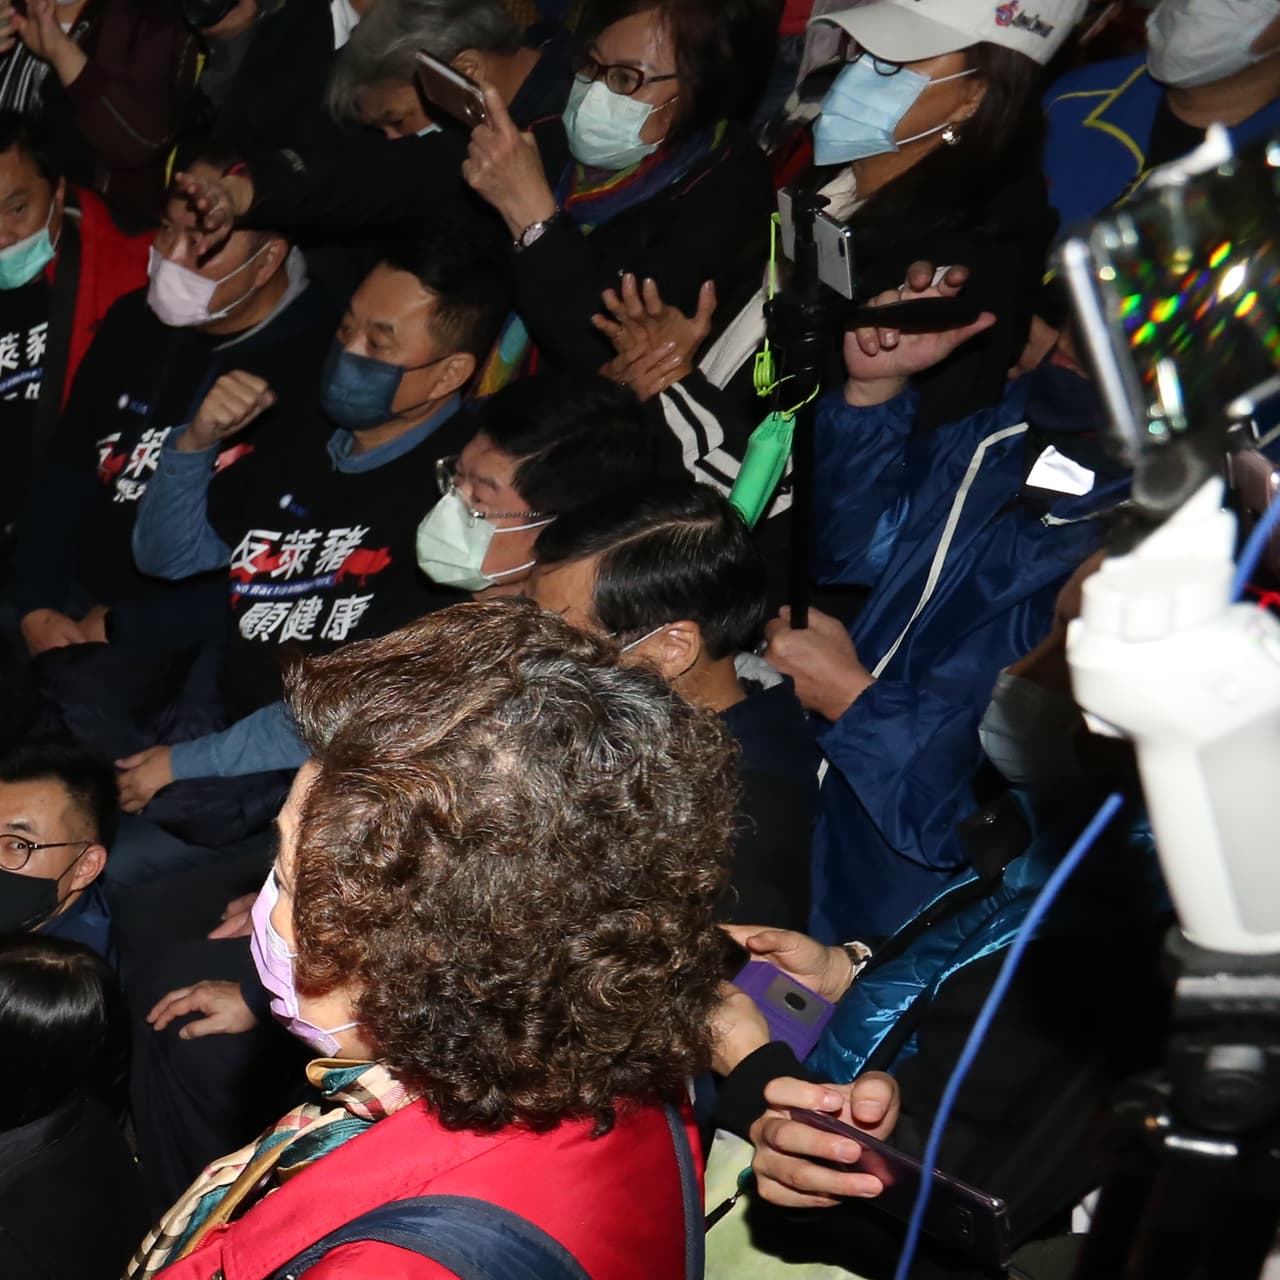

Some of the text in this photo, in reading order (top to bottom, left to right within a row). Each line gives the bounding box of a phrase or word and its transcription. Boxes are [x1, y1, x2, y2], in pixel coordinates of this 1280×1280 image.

[231, 523, 372, 581] 反萊豬
[238, 592, 376, 644] 顧健康
